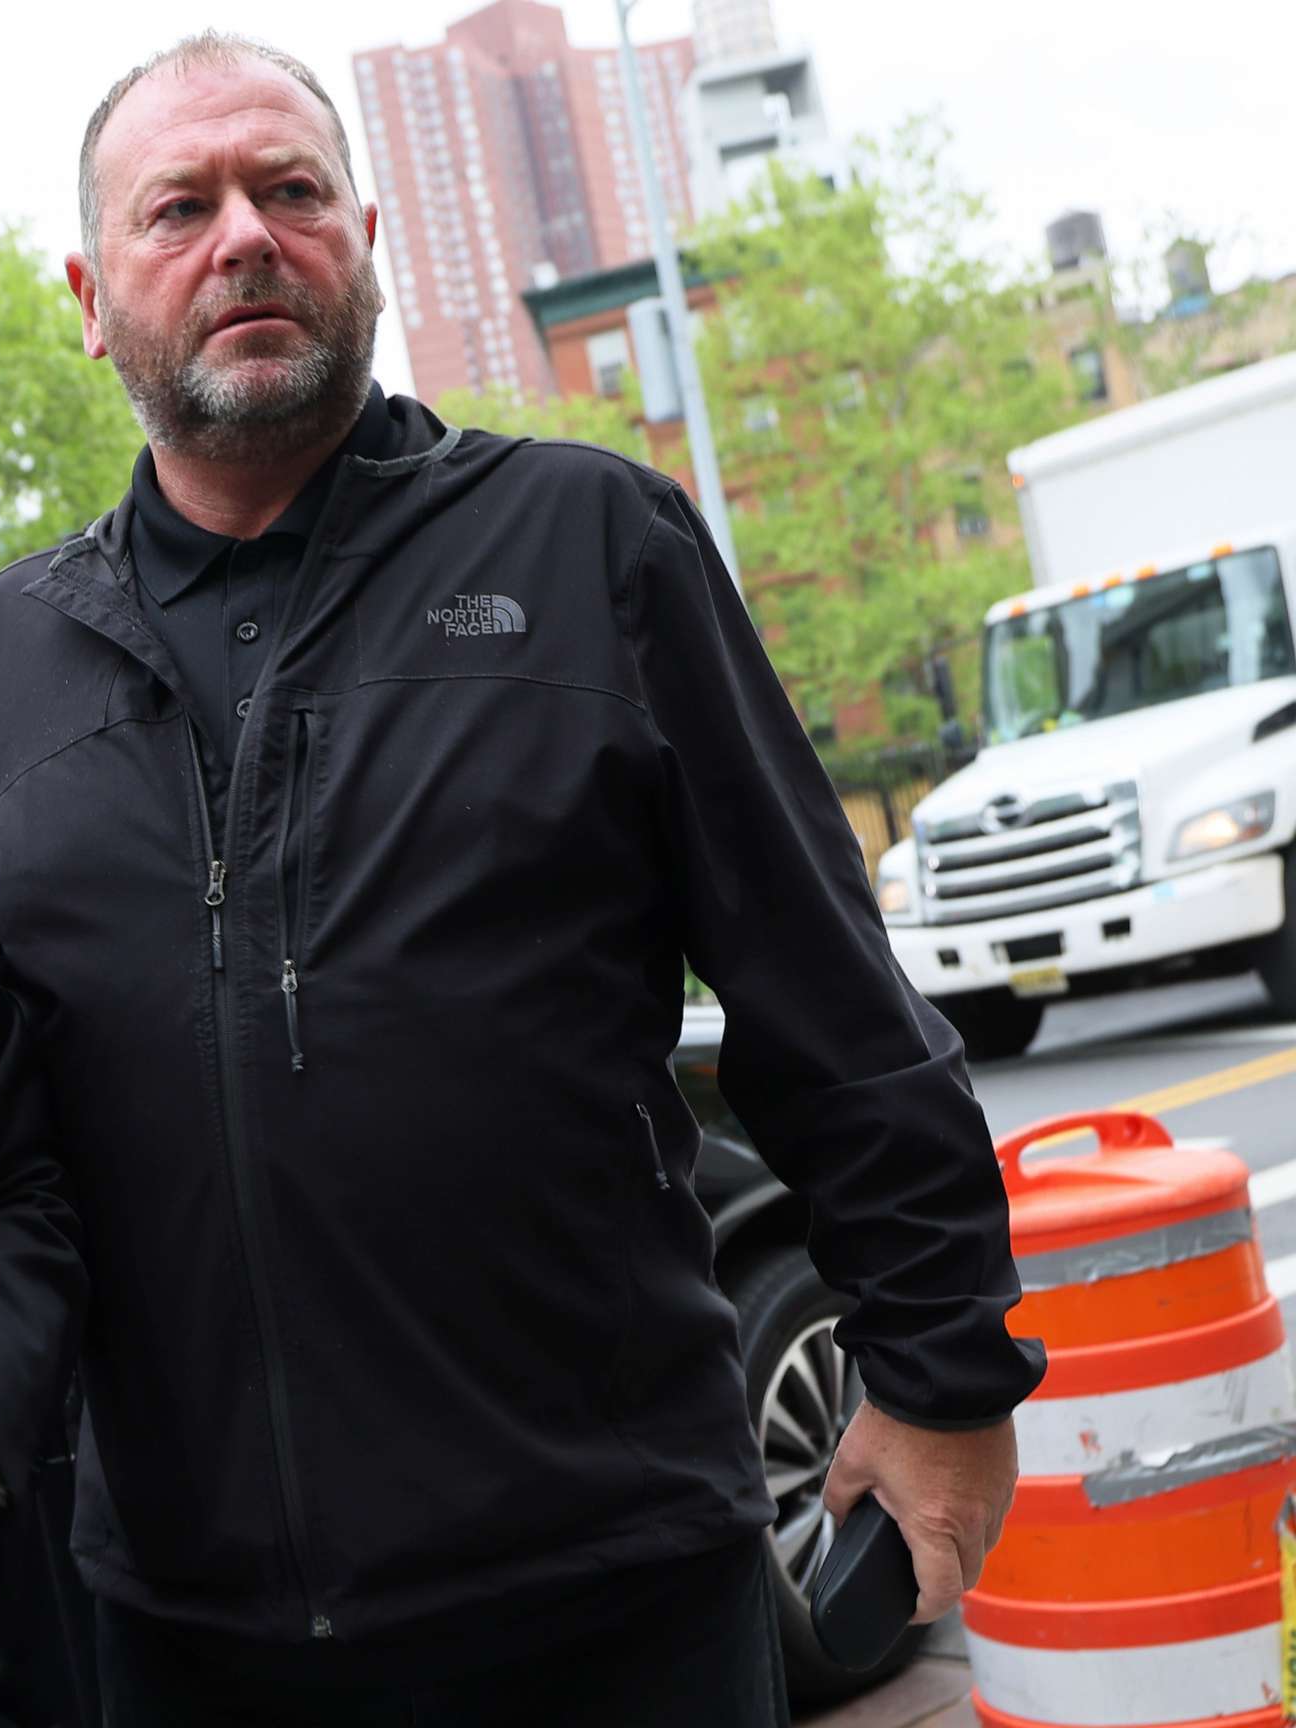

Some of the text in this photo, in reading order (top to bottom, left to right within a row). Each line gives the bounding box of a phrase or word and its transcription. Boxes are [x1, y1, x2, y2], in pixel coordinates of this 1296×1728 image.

[455, 594, 492, 609] THE
[426, 608, 492, 625] NORTH
[445, 621, 493, 637] FACE
